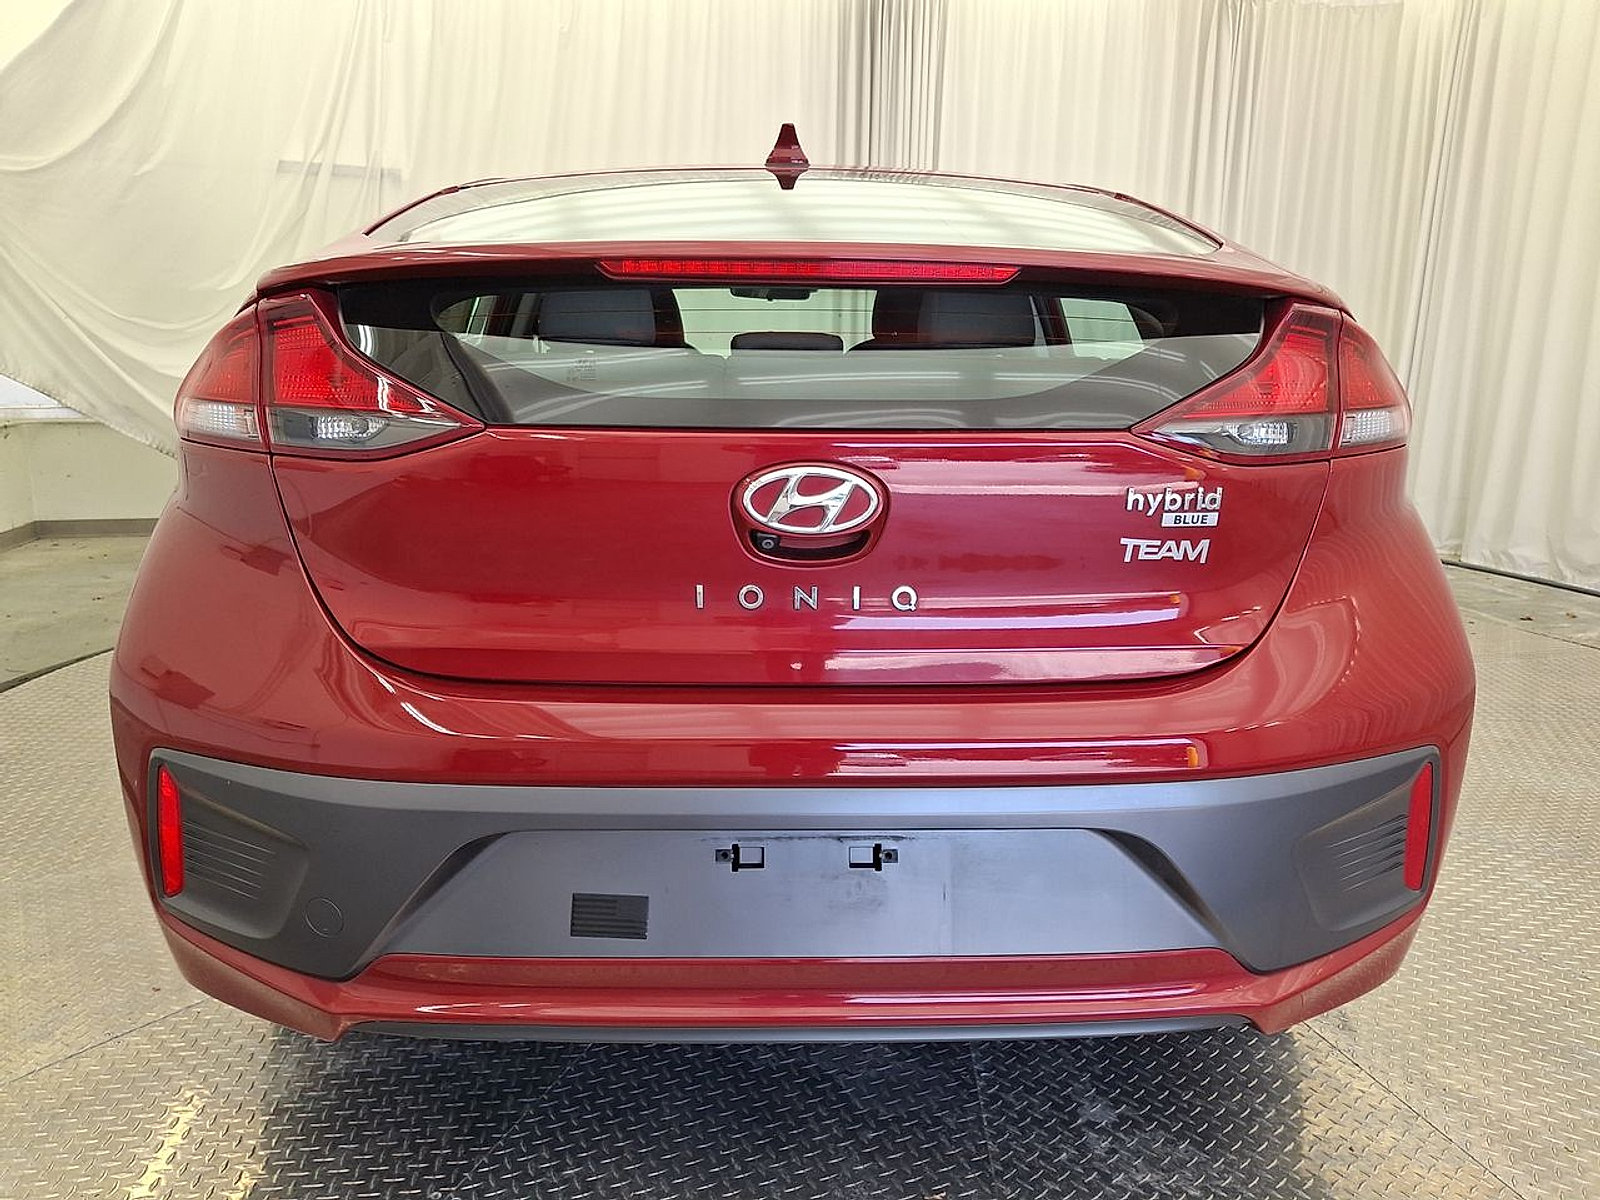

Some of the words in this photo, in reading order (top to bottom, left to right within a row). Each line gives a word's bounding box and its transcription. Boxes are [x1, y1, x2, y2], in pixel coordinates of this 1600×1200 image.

[1126, 487, 1223, 516] hybrid
[1173, 514, 1209, 525] BLUE
[1120, 538, 1210, 564] TEAM
[695, 584, 918, 611] IONIQ
